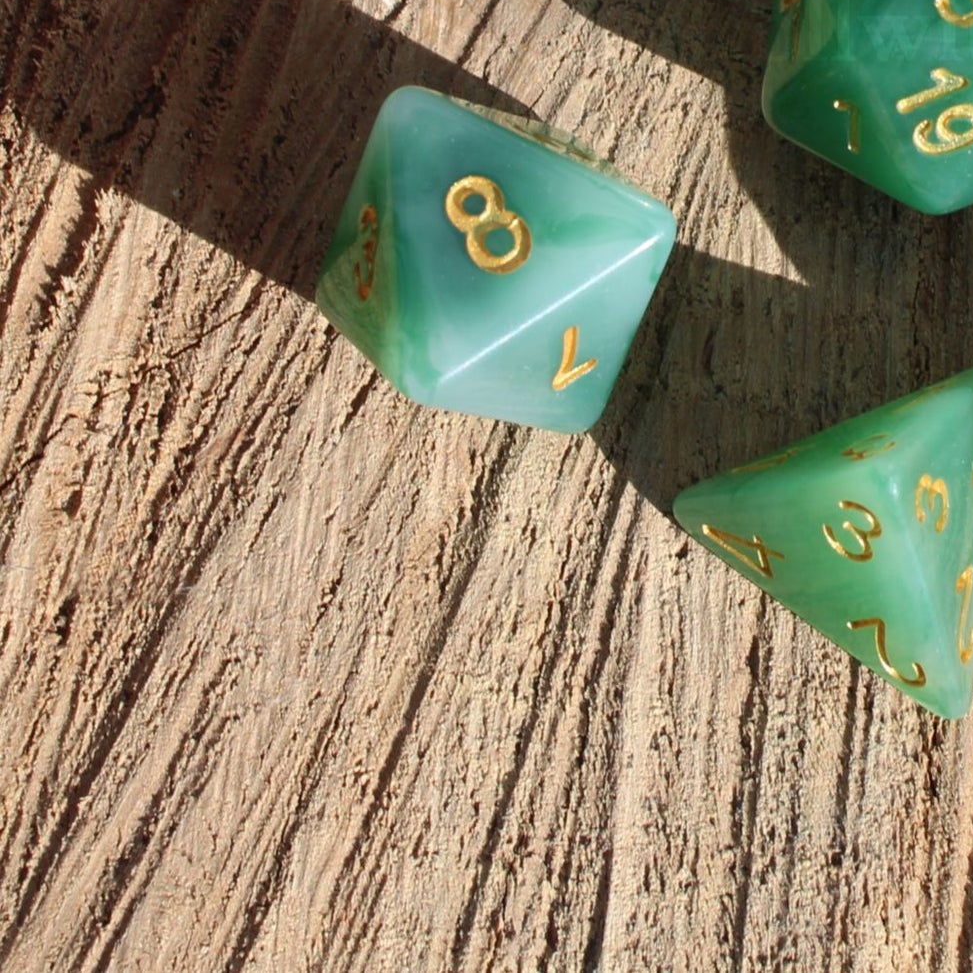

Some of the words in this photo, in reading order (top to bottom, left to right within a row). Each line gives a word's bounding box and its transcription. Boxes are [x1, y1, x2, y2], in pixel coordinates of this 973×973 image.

[446, 175, 532, 274] 8
[821, 500, 882, 562] 3
[915, 474, 949, 535] 3
[702, 524, 785, 578] 4
[846, 617, 927, 687] 2
